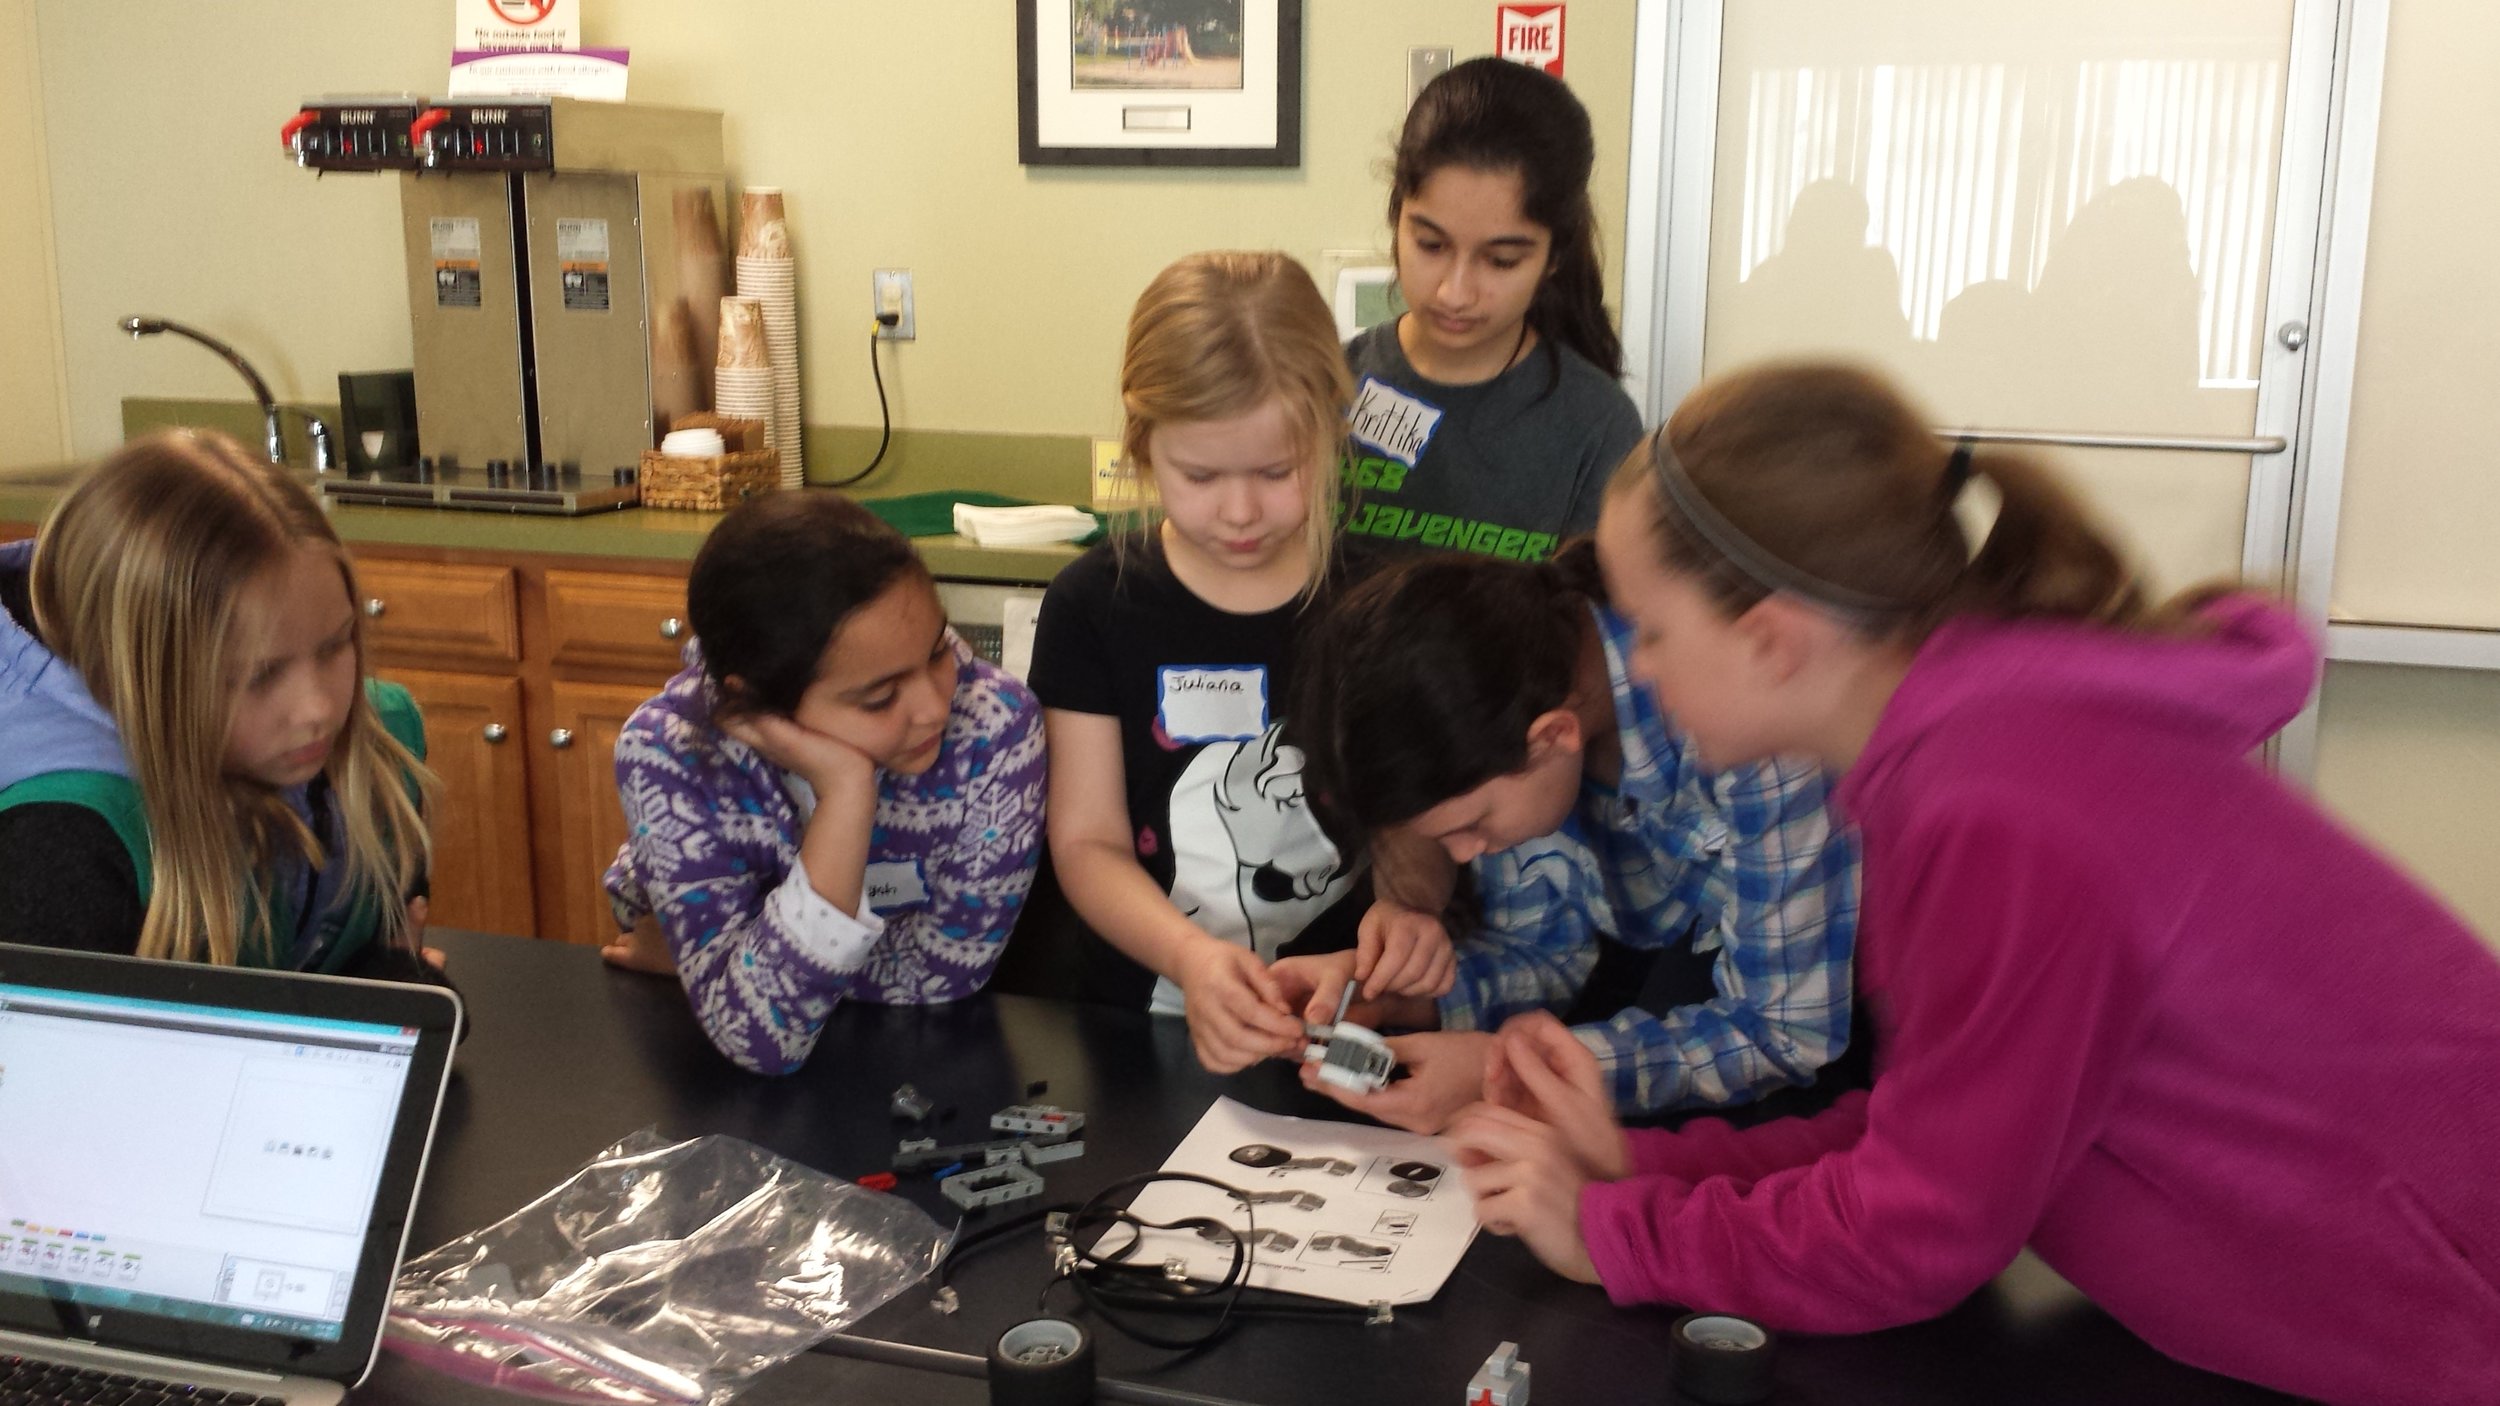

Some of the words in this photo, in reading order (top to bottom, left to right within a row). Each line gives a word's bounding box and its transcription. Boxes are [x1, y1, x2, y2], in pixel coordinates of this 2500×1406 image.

[1508, 25, 1553, 52] FIRE
[340, 110, 374, 126] BUNN
[471, 109, 506, 125] BUNN
[1170, 674, 1244, 694] Juliana
